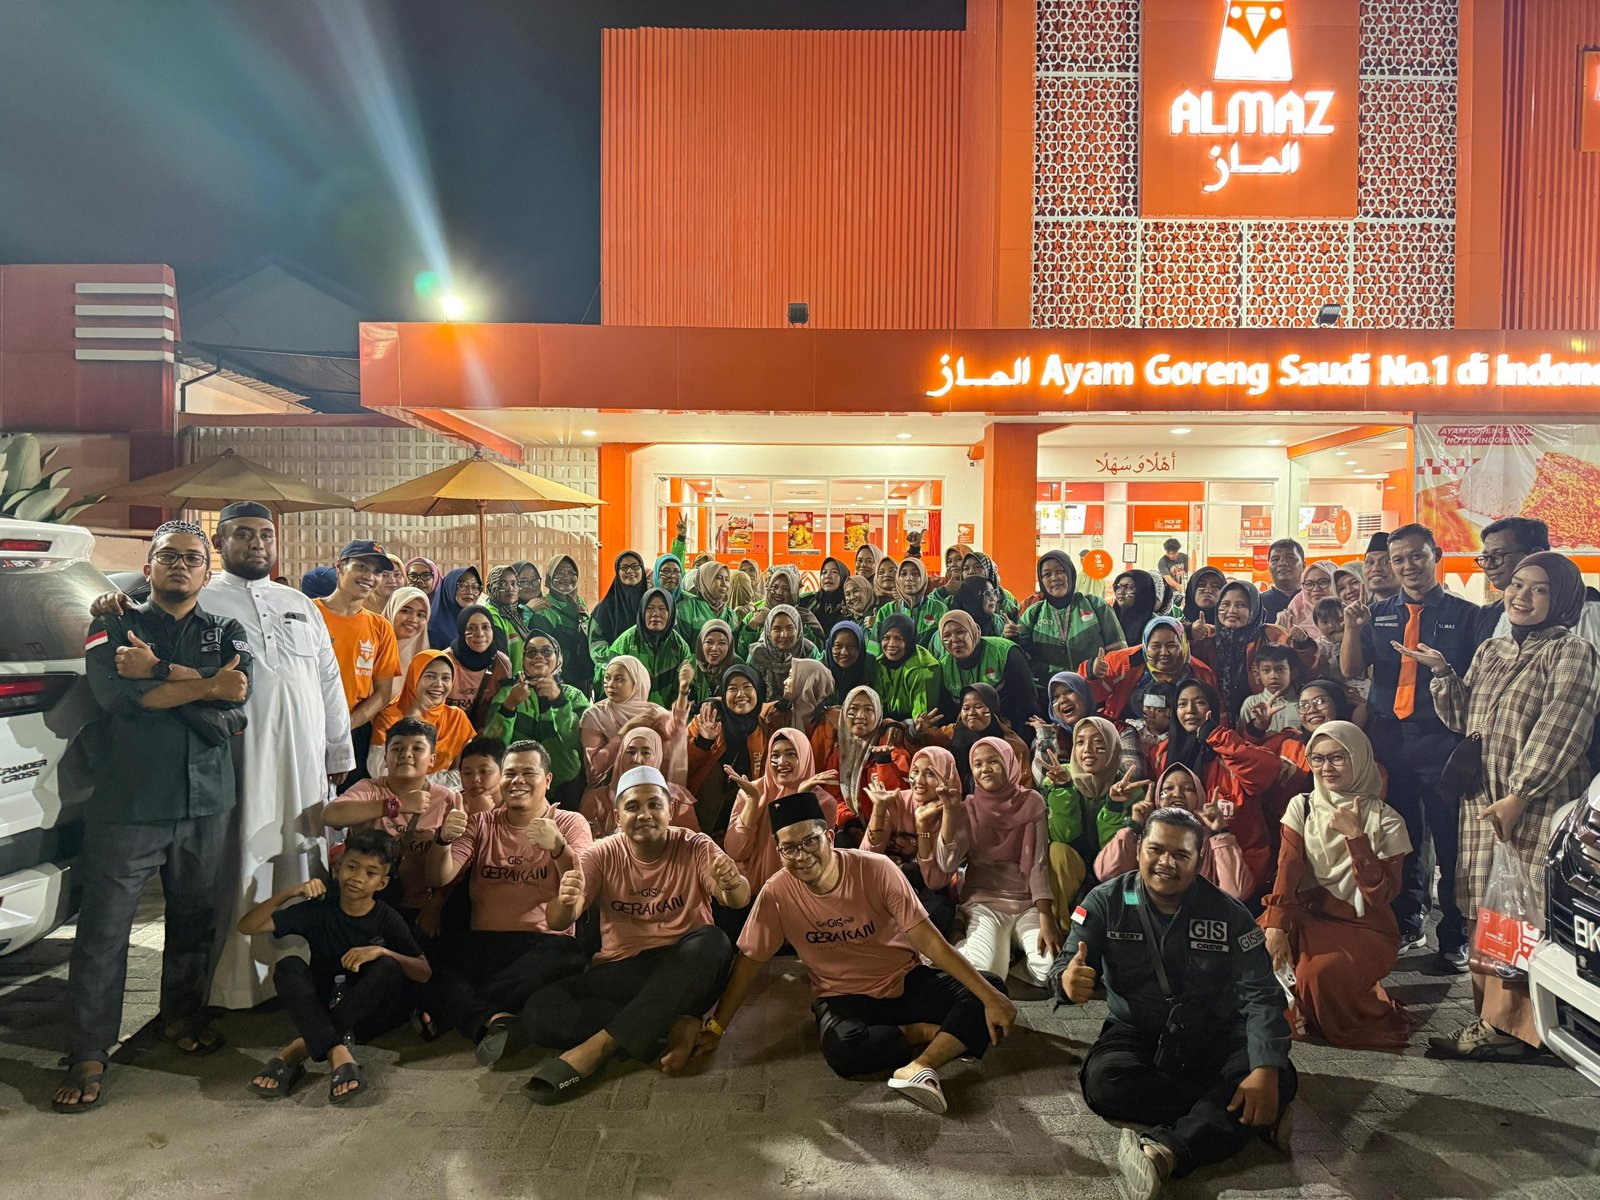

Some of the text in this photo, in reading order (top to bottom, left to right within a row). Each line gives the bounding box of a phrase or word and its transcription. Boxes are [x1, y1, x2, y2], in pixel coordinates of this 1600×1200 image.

[1170, 89, 1335, 134] ALMAZ
[1041, 354, 1134, 394] Ayam
[1145, 353, 1270, 395] Goreng
[1279, 353, 1370, 386] Saudi
[1456, 352, 1489, 386] di
[1, 769, 40, 784] CROSS
[507, 855, 524, 865] GIS
[480, 865, 548, 882] GERAKAN
[641, 887, 658, 898] GIS
[611, 895, 685, 916] GERAKAN
[827, 917, 844, 928] GIS
[1191, 920, 1225, 940] GIS
[805, 920, 876, 944] GERAKAN
[1240, 932, 1259, 949] GIS
[1196, 943, 1224, 951] CREW
